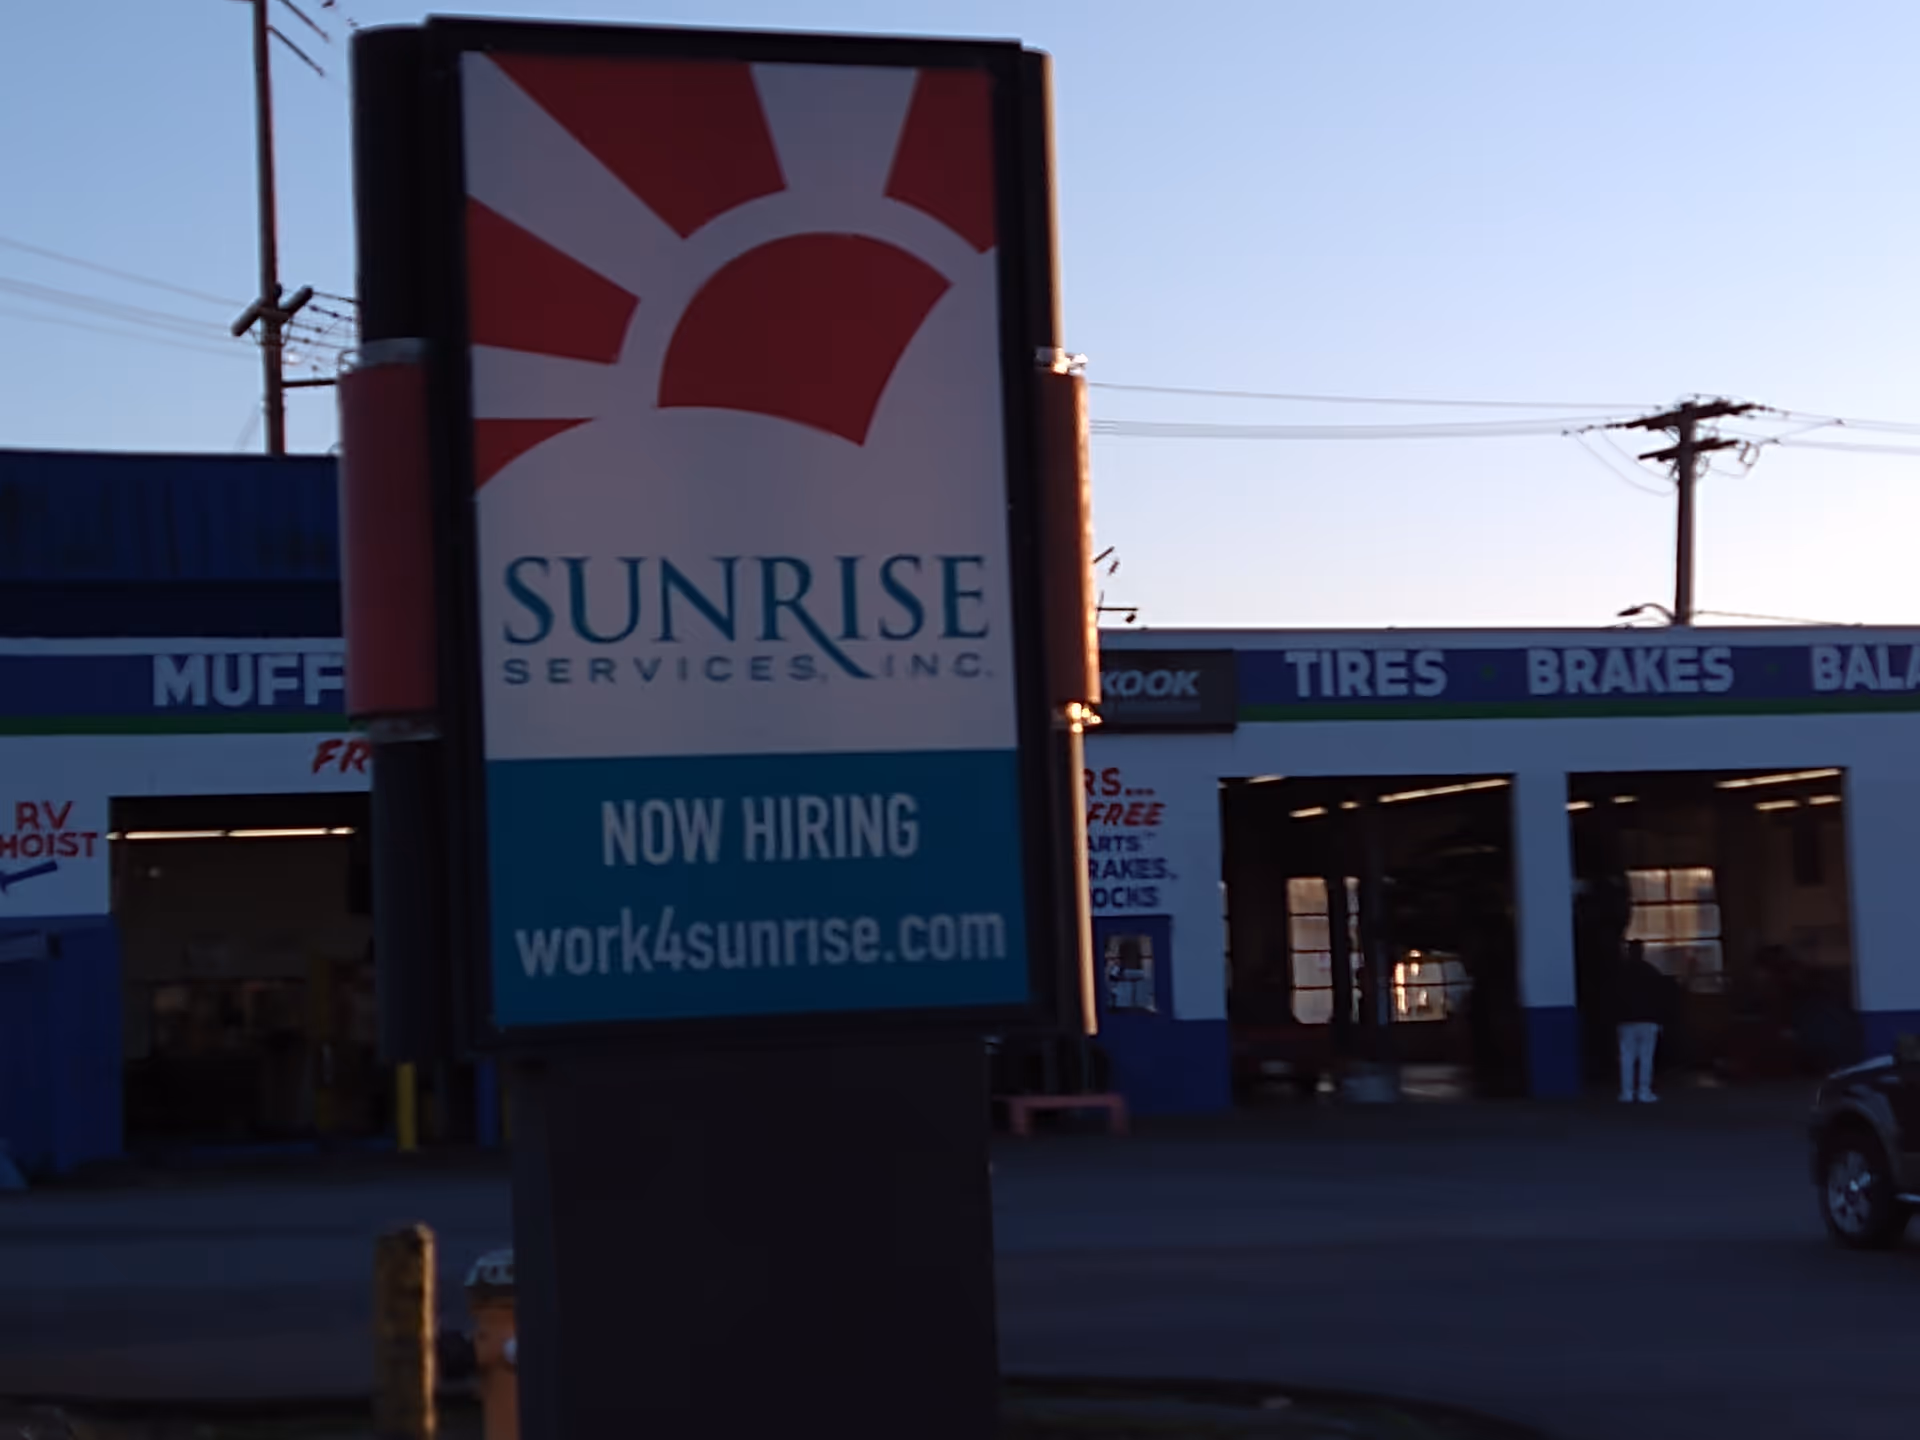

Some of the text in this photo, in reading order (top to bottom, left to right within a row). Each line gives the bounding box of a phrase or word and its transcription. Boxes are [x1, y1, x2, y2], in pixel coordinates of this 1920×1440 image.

[503, 554, 989, 679] SUNRISE
[152, 653, 345, 706] MUFF
[884, 653, 993, 678] INC.
[1284, 649, 1448, 697] TIRES
[1527, 646, 1735, 694] BRAKES
[15, 800, 73, 831] RV
[601, 792, 920, 867] NOW HIRING
[1087, 802, 1166, 827] FREE
[0, 832, 98, 859] HOIST
[514, 905, 1007, 980] work4sunrise.com
